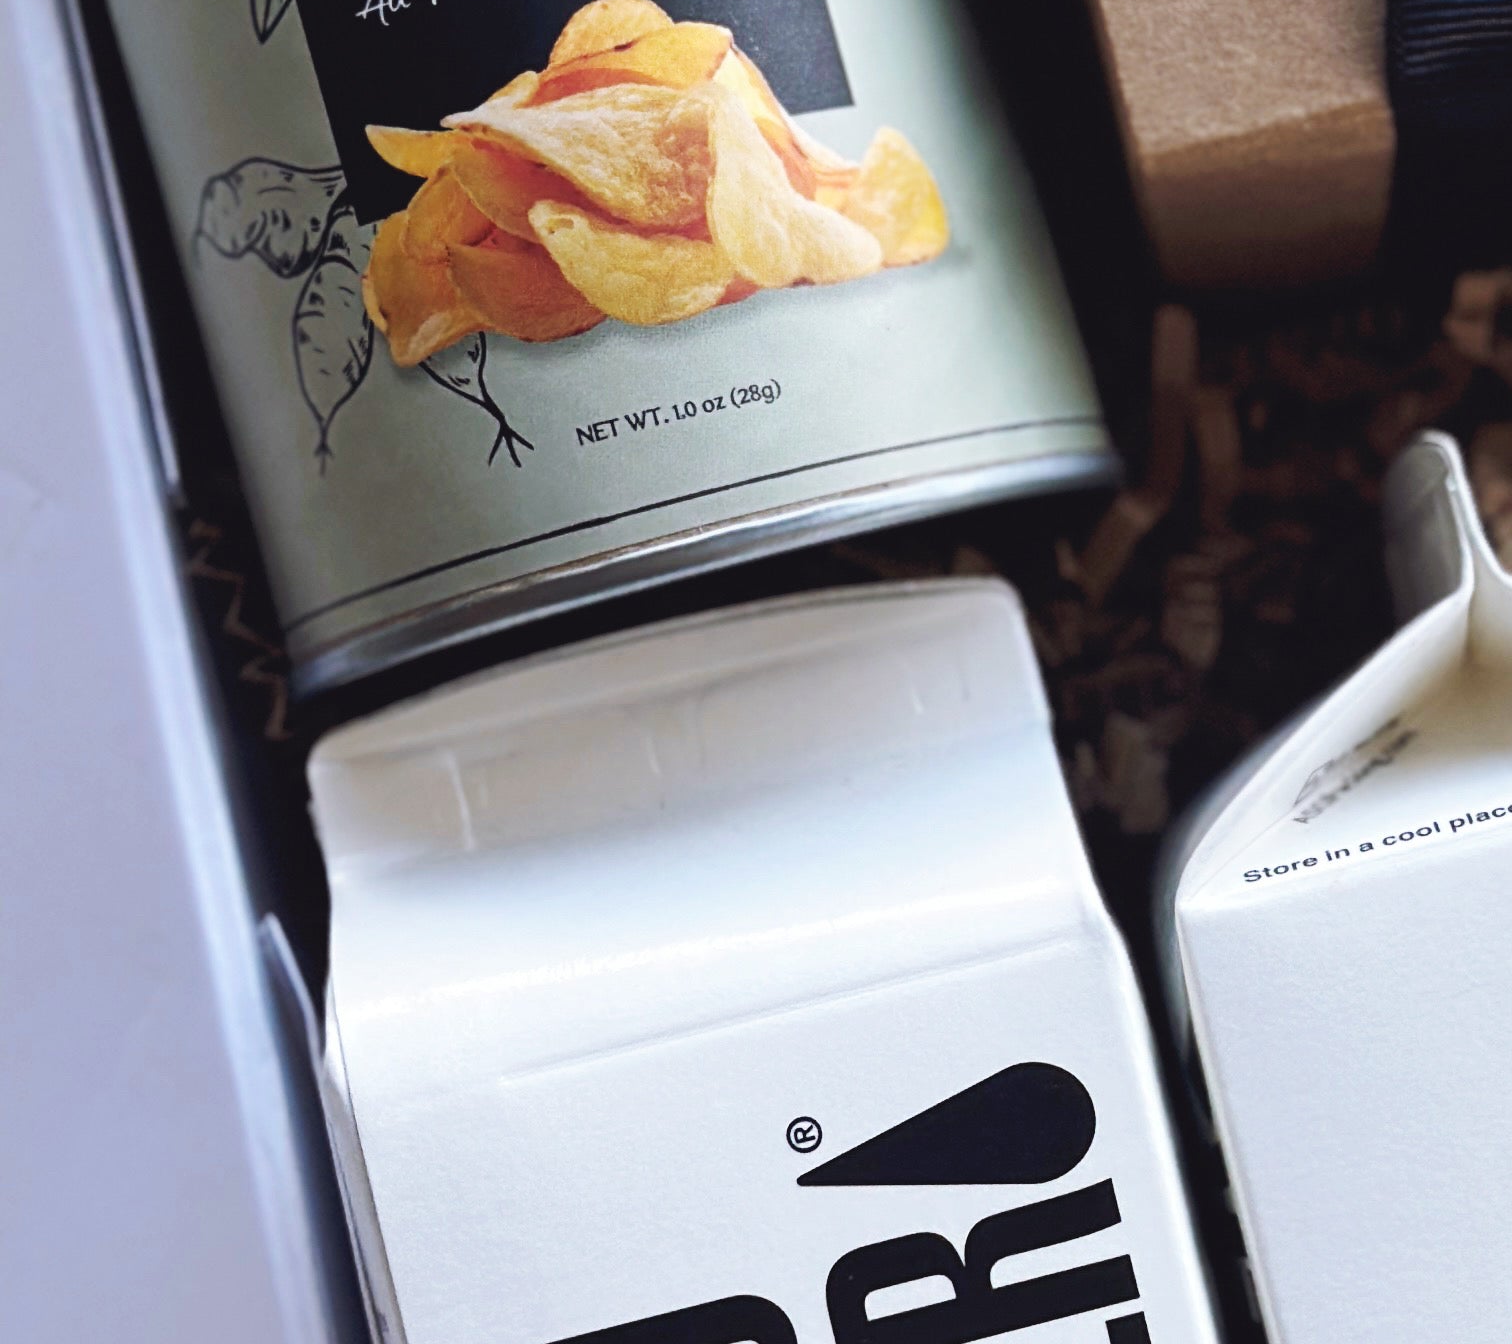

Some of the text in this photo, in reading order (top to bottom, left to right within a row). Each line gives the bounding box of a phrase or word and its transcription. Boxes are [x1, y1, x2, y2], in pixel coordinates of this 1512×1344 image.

[575, 417, 620, 446] NET
[624, 407, 669, 431] WT.
[702, 396, 727, 413] oz
[730, 379, 782, 409] (28g)
[1243, 854, 1318, 883] Store
[1325, 847, 1351, 862] in
[1358, 840, 1374, 854] a
[1382, 820, 1442, 847] cool
